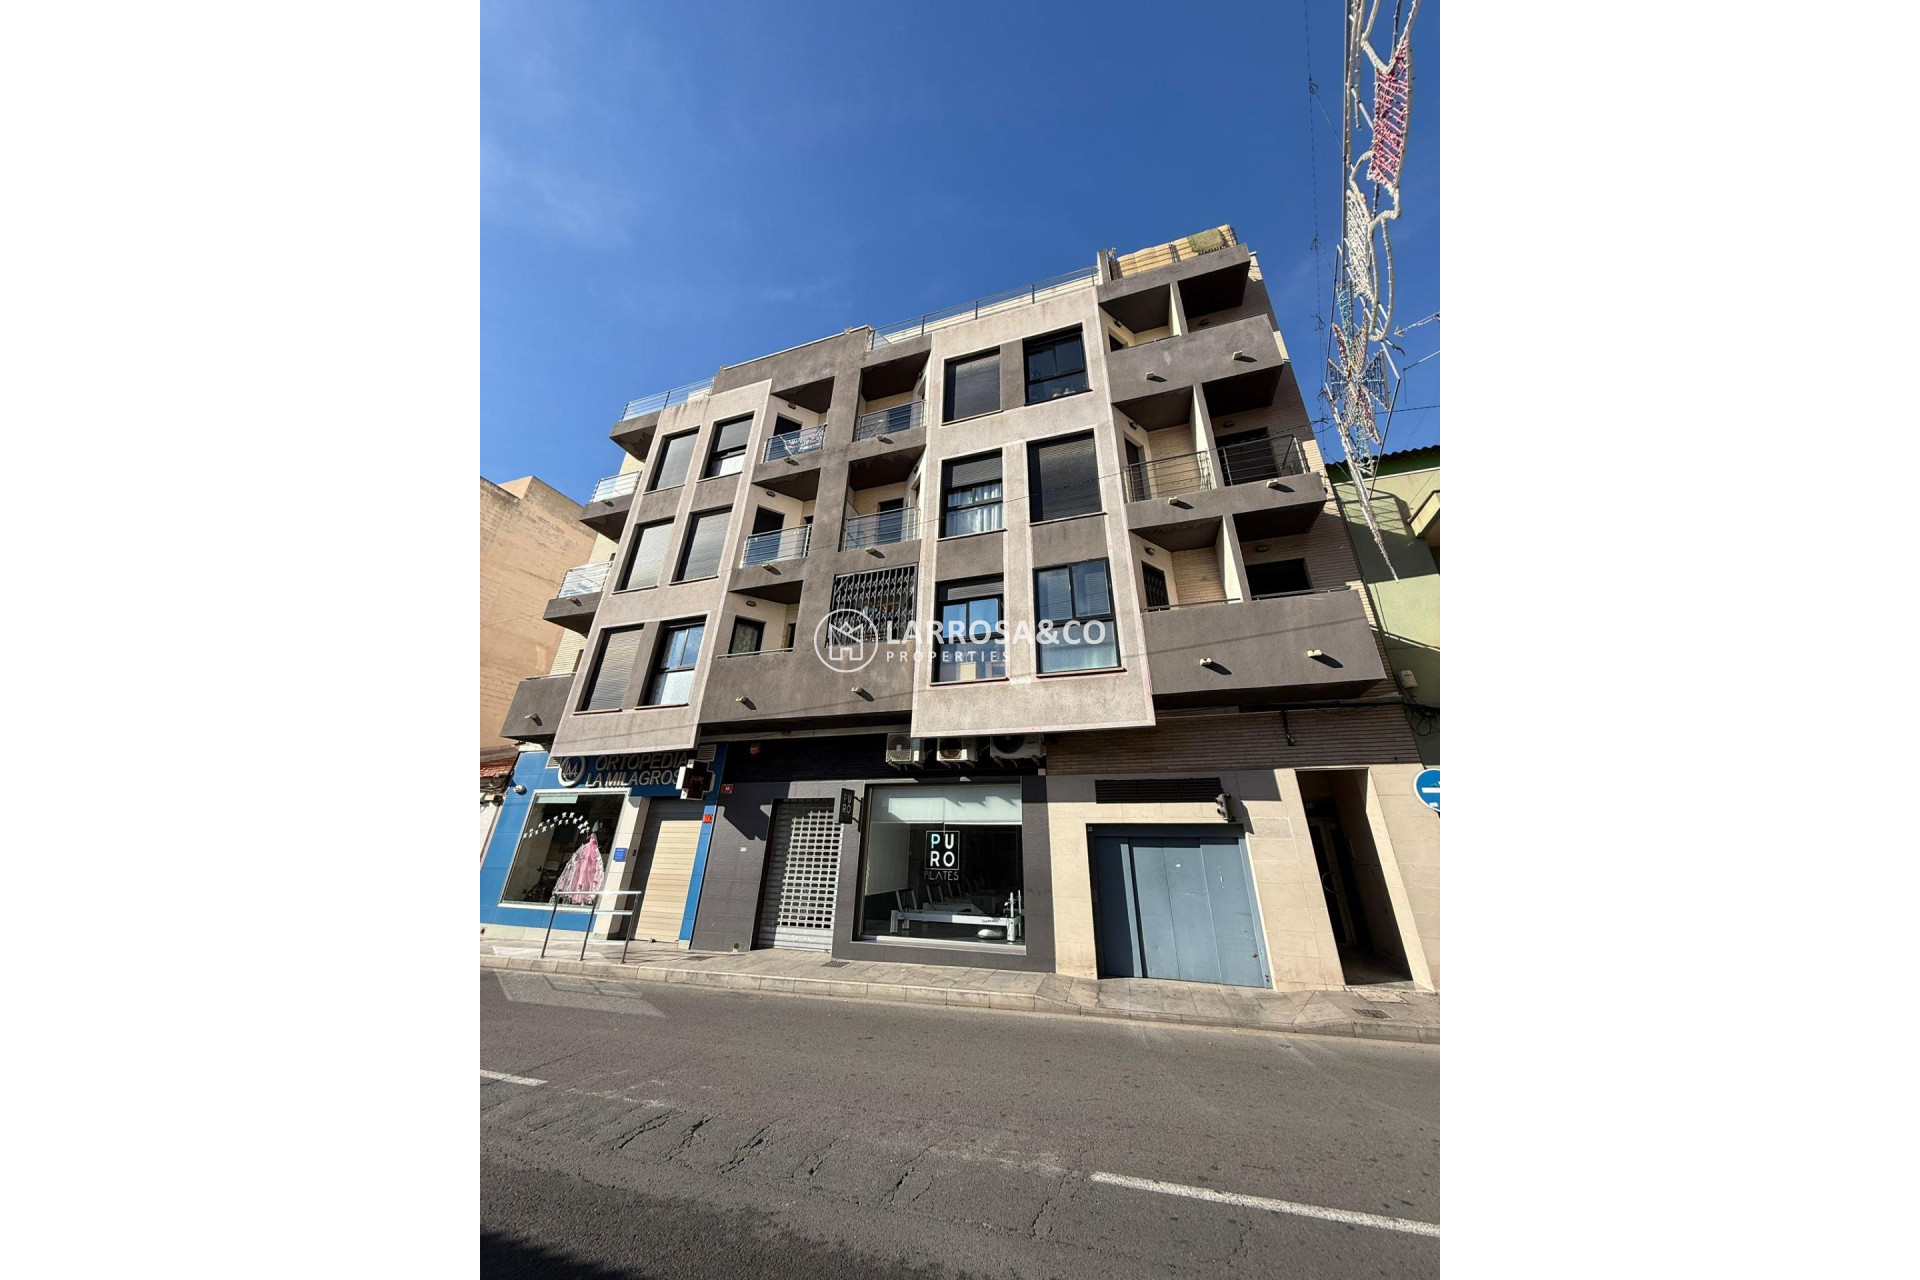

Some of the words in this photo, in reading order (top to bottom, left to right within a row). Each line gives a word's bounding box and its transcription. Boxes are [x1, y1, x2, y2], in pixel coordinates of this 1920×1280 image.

[595, 751, 689, 771] ORTOPEDIA
[585, 770, 603, 788] LA
[930, 833, 955, 850] PU
[929, 850, 956, 868] RO
